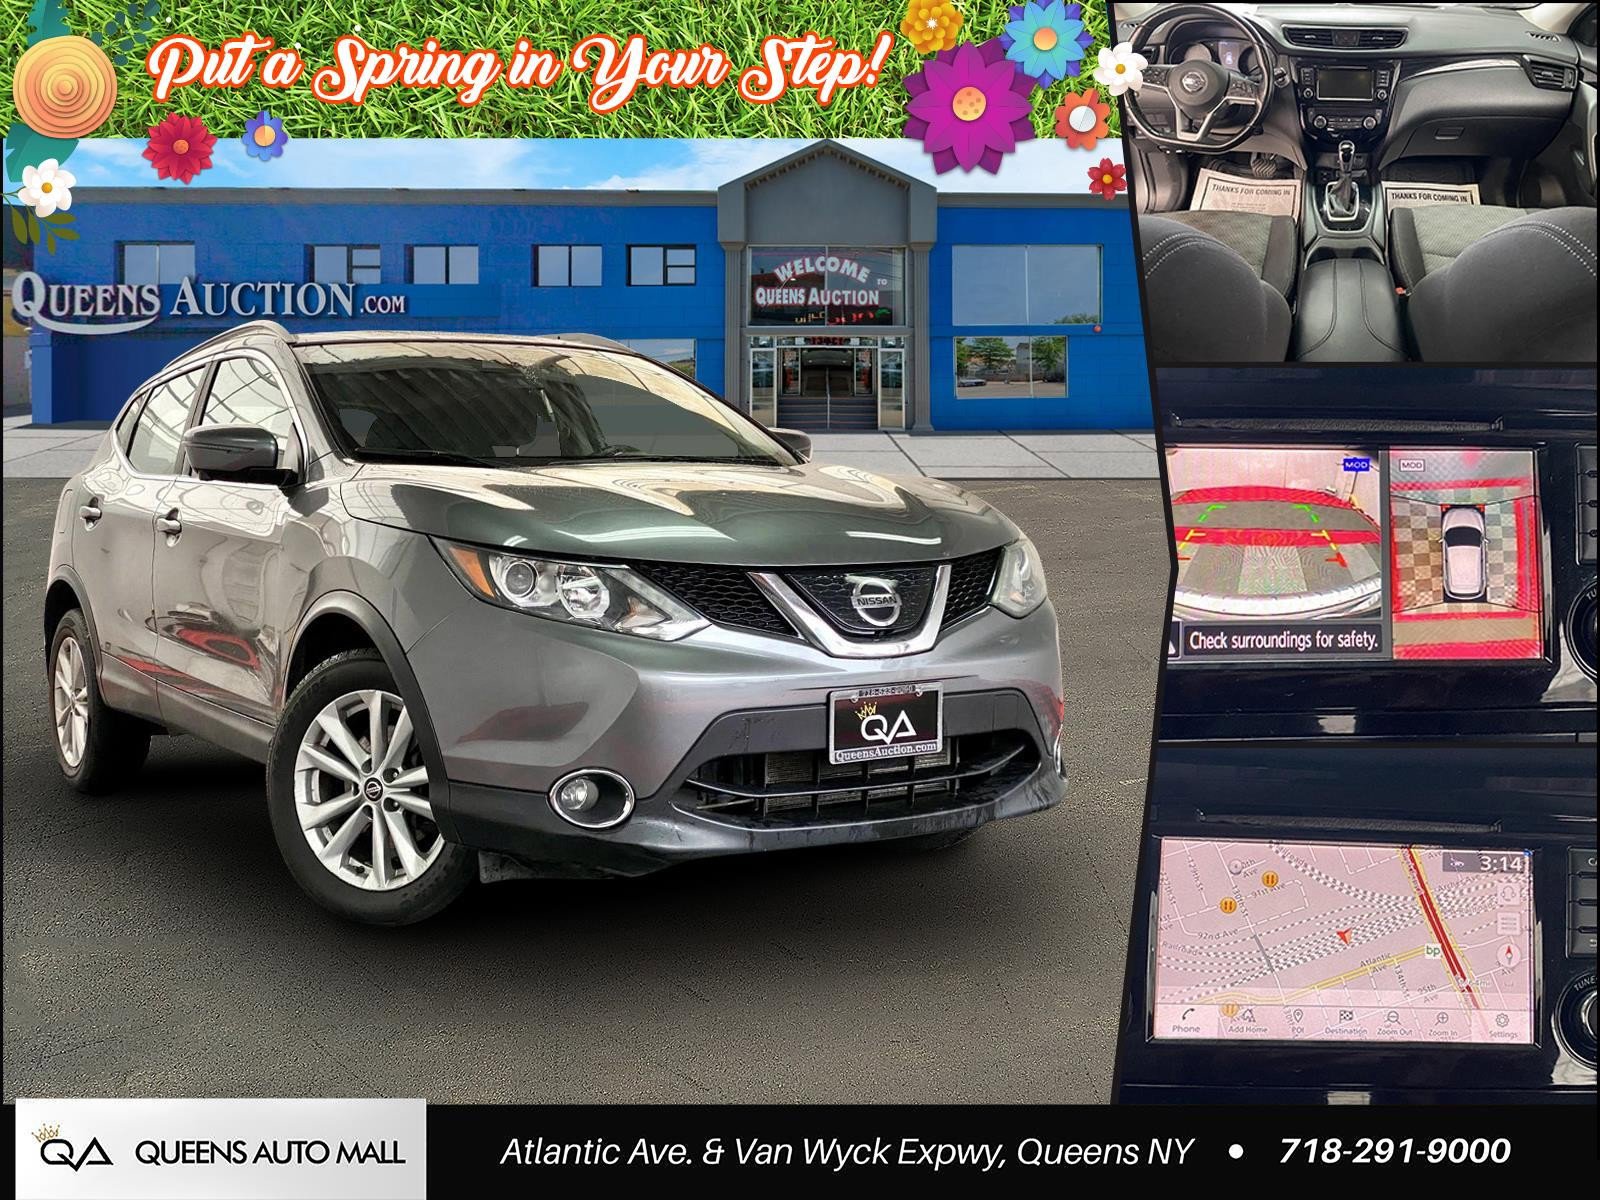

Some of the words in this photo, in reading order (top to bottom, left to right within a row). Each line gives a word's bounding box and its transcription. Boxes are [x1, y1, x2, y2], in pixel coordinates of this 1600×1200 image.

[1212, 184, 1239, 194] THANKS
[1256, 188, 1282, 196] COMING
[1392, 191, 1417, 200] THANKS
[1433, 194, 1459, 202] COMING
[773, 255, 871, 284] WELCOME
[755, 286, 805, 306] QUEENS
[808, 287, 880, 306] AUCTION
[12, 271, 161, 335] QUEENS
[1345, 461, 1369, 469] MOD
[856, 596, 898, 606] NISSAN
[1189, 631, 1228, 649] Check
[1231, 630, 1312, 651] surroundings
[1315, 630, 1335, 648] for
[1337, 630, 1378, 651] safety.
[836, 742, 937, 762] QueensAuction.com
[1480, 855, 1523, 872] 3:14
[1198, 930, 1221, 940] 92nd
[1222, 928, 1239, 938] Ave
[1426, 945, 1441, 957] bp
[1360, 952, 1391, 967] Atlantic
[1172, 1025, 1200, 1033] Phone
[1228, 1025, 1245, 1033] Add
[1291, 1026, 1305, 1034] POI
[1325, 1027, 1367, 1036] Destination
[1377, 1028, 1398, 1036] Zoom
[1399, 1027, 1413, 1036] Out
[1489, 1030, 1518, 1038] Settings
